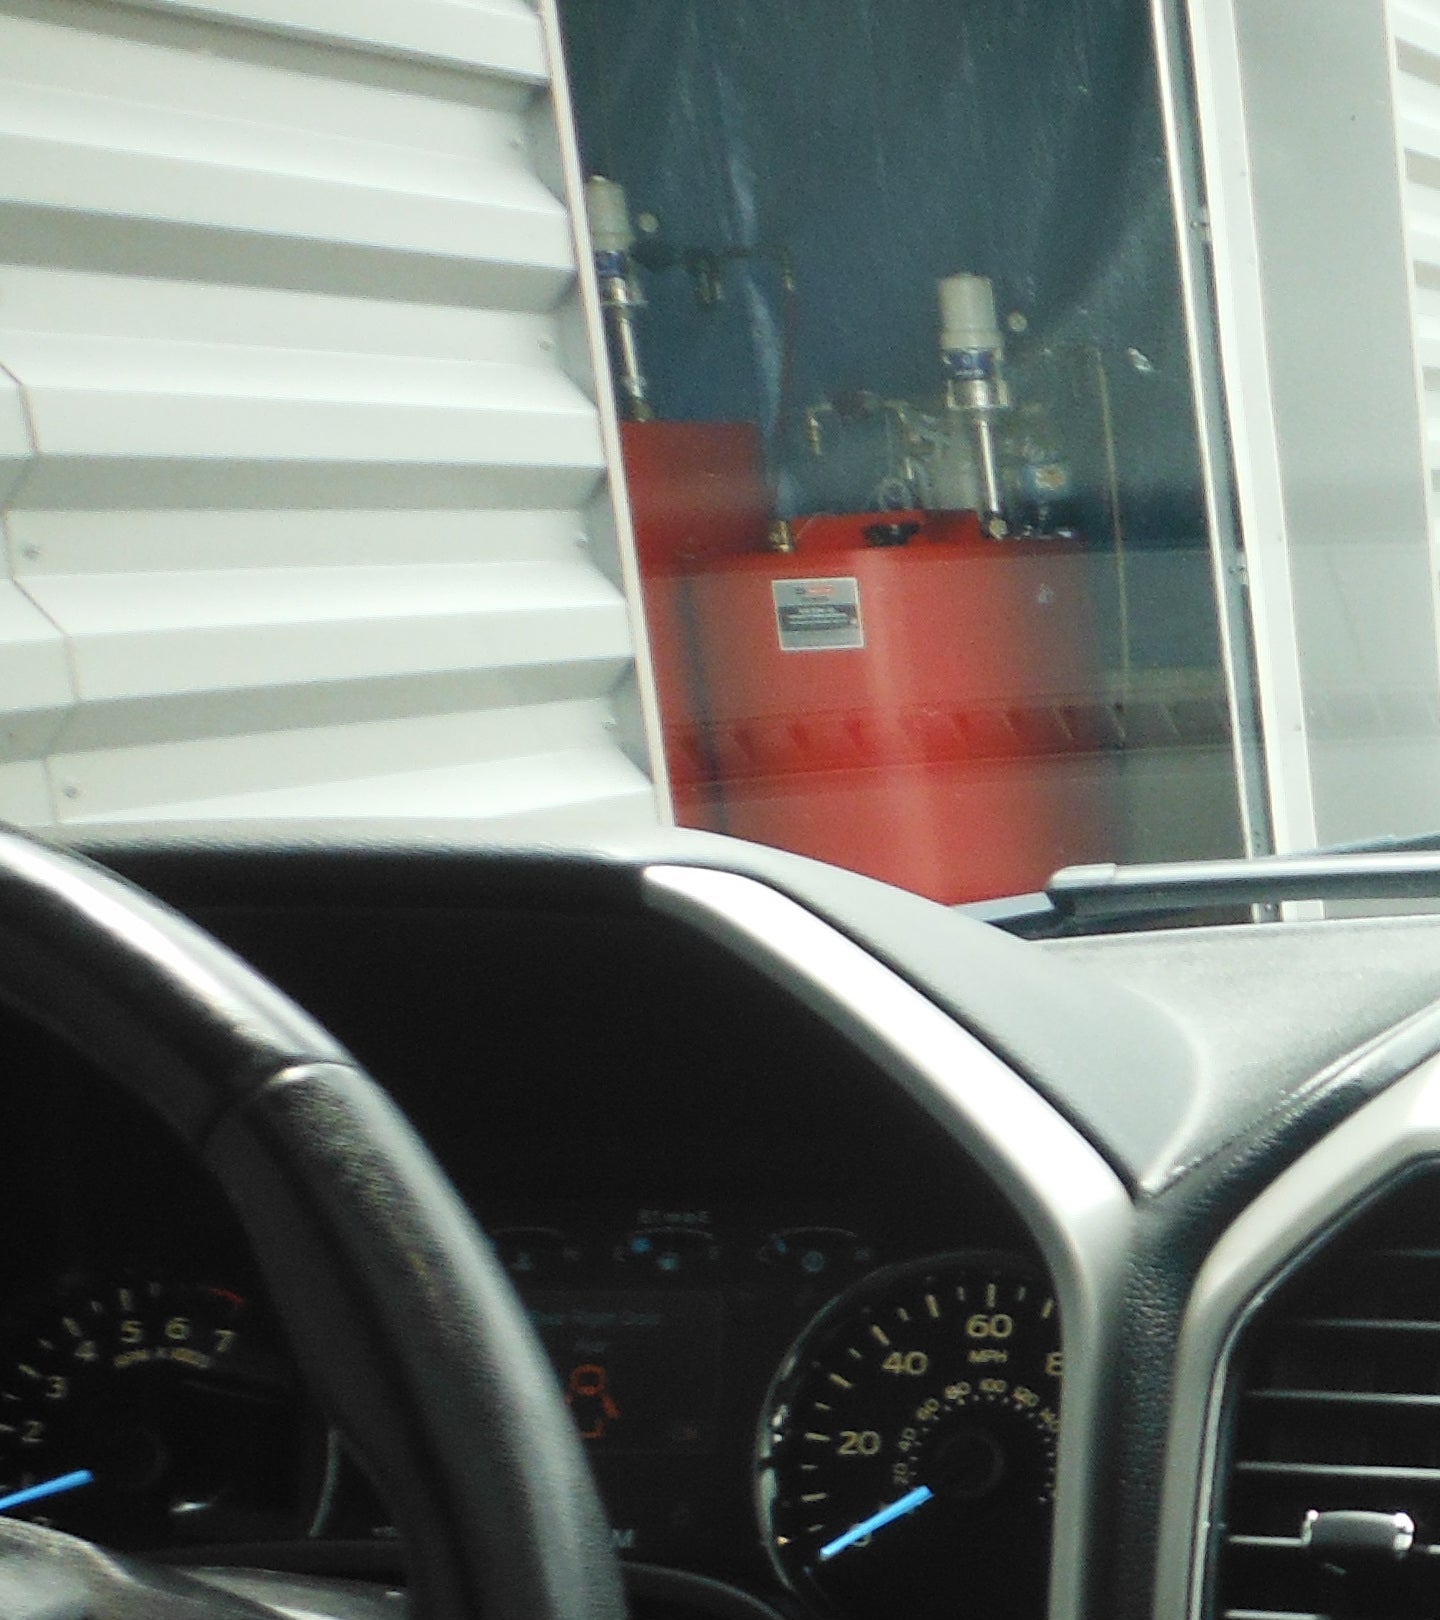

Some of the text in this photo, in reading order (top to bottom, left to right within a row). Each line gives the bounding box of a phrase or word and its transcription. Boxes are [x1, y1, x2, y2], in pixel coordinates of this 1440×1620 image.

[120, 1320, 144, 1343] 5
[164, 1316, 191, 1341] 6
[966, 1314, 1013, 1339] 60
[214, 1328, 236, 1352] 7
[882, 1351, 928, 1375] 40
[1045, 1351, 1064, 1377] 8
[45, 1376, 67, 1398] 3
[21, 1420, 45, 1443] 2
[837, 1430, 881, 1455] 20
